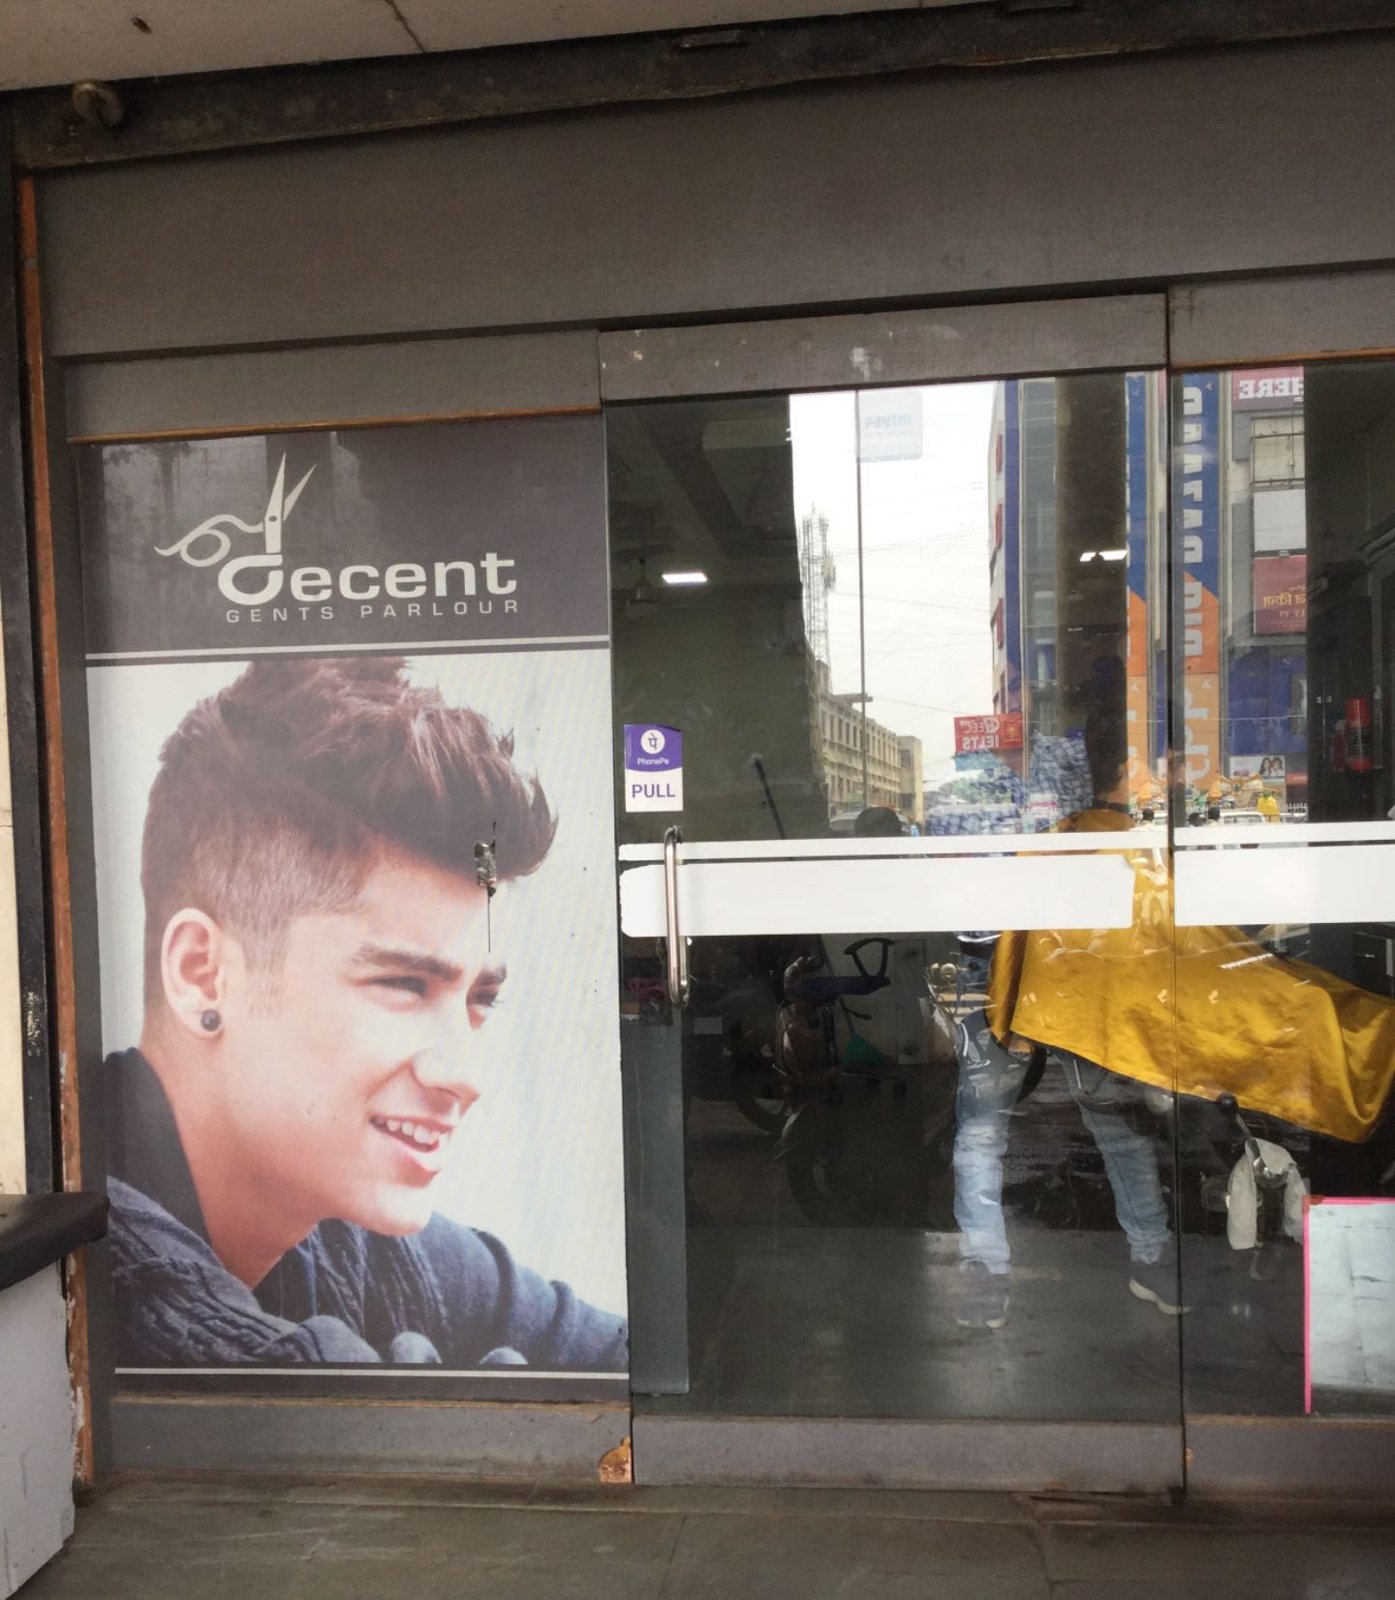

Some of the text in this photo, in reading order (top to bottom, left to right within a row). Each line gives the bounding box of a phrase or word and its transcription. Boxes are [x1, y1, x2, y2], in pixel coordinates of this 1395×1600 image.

[226, 600, 518, 623] GENTS PARLOUR
[637, 757, 670, 765] PhonePe
[632, 784, 676, 798] PULL
